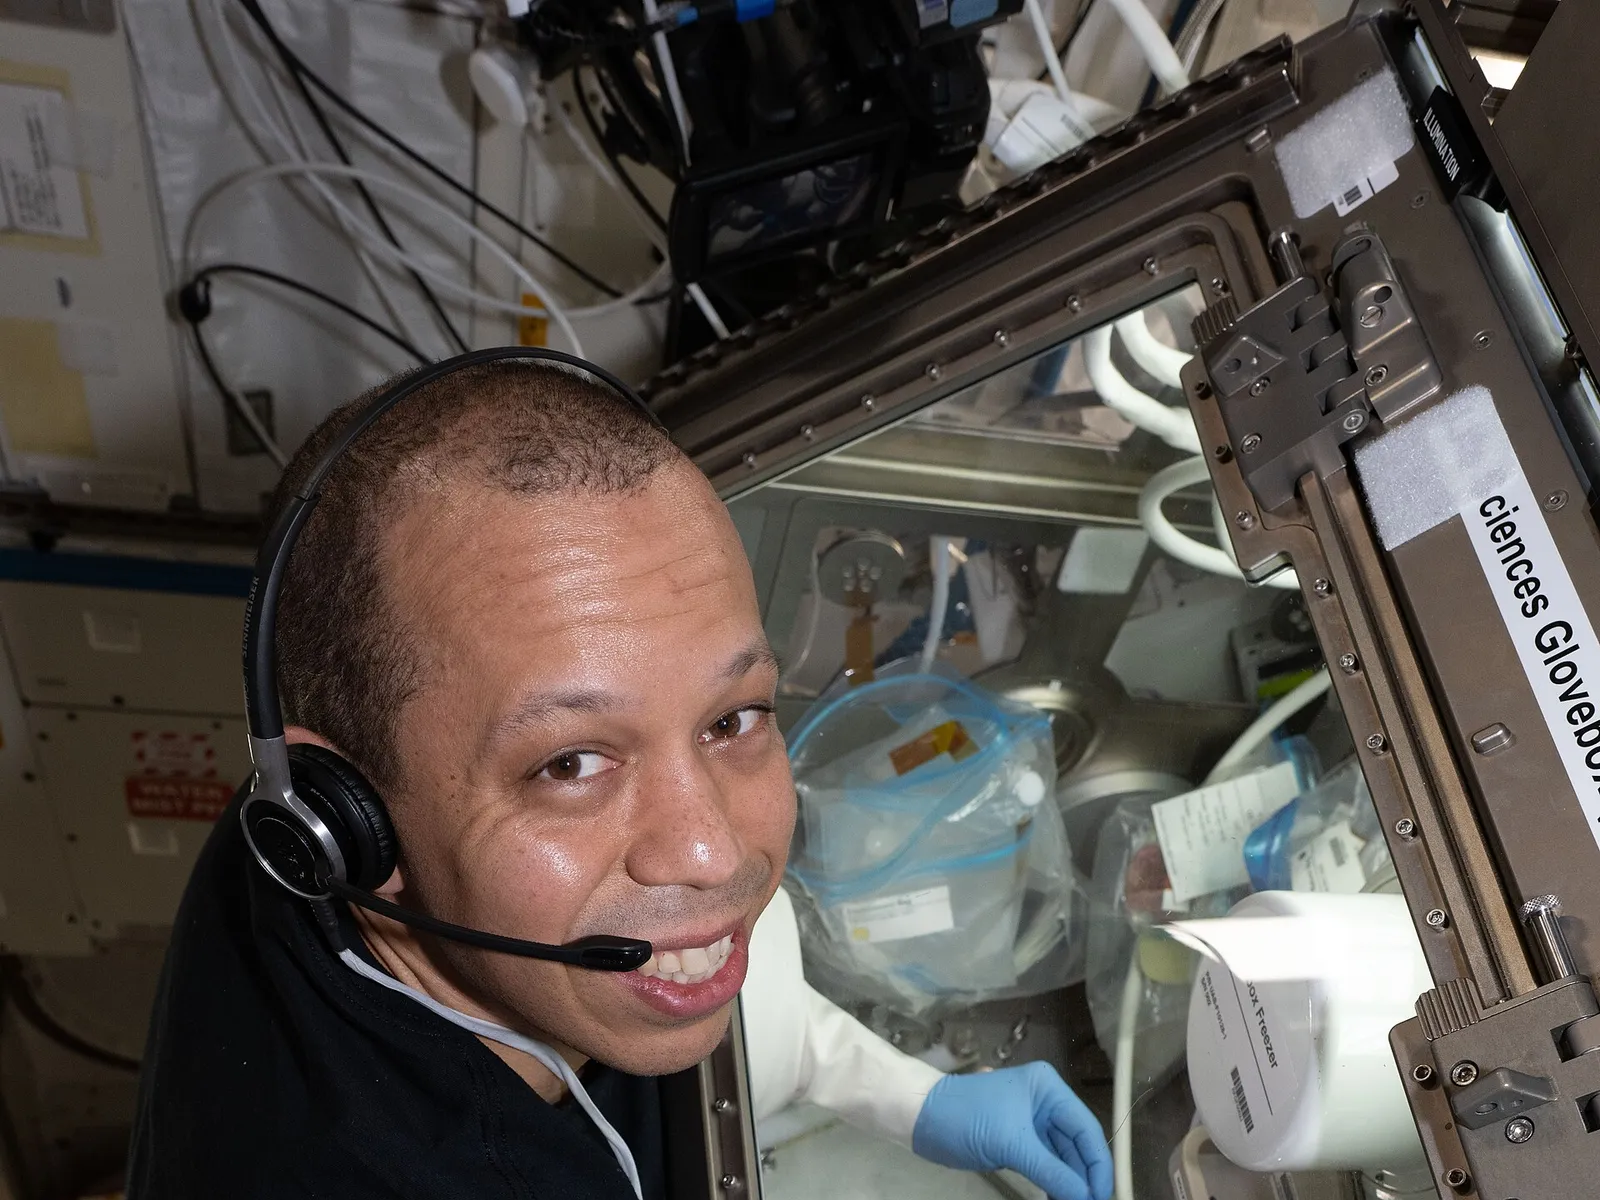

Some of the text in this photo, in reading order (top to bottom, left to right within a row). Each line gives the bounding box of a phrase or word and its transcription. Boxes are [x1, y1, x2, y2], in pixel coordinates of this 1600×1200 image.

[1423, 107, 1460, 181] ILLUMINATION
[242, 576, 259, 658] SENNHEISER
[1256, 1006, 1278, 1069] Freezer
